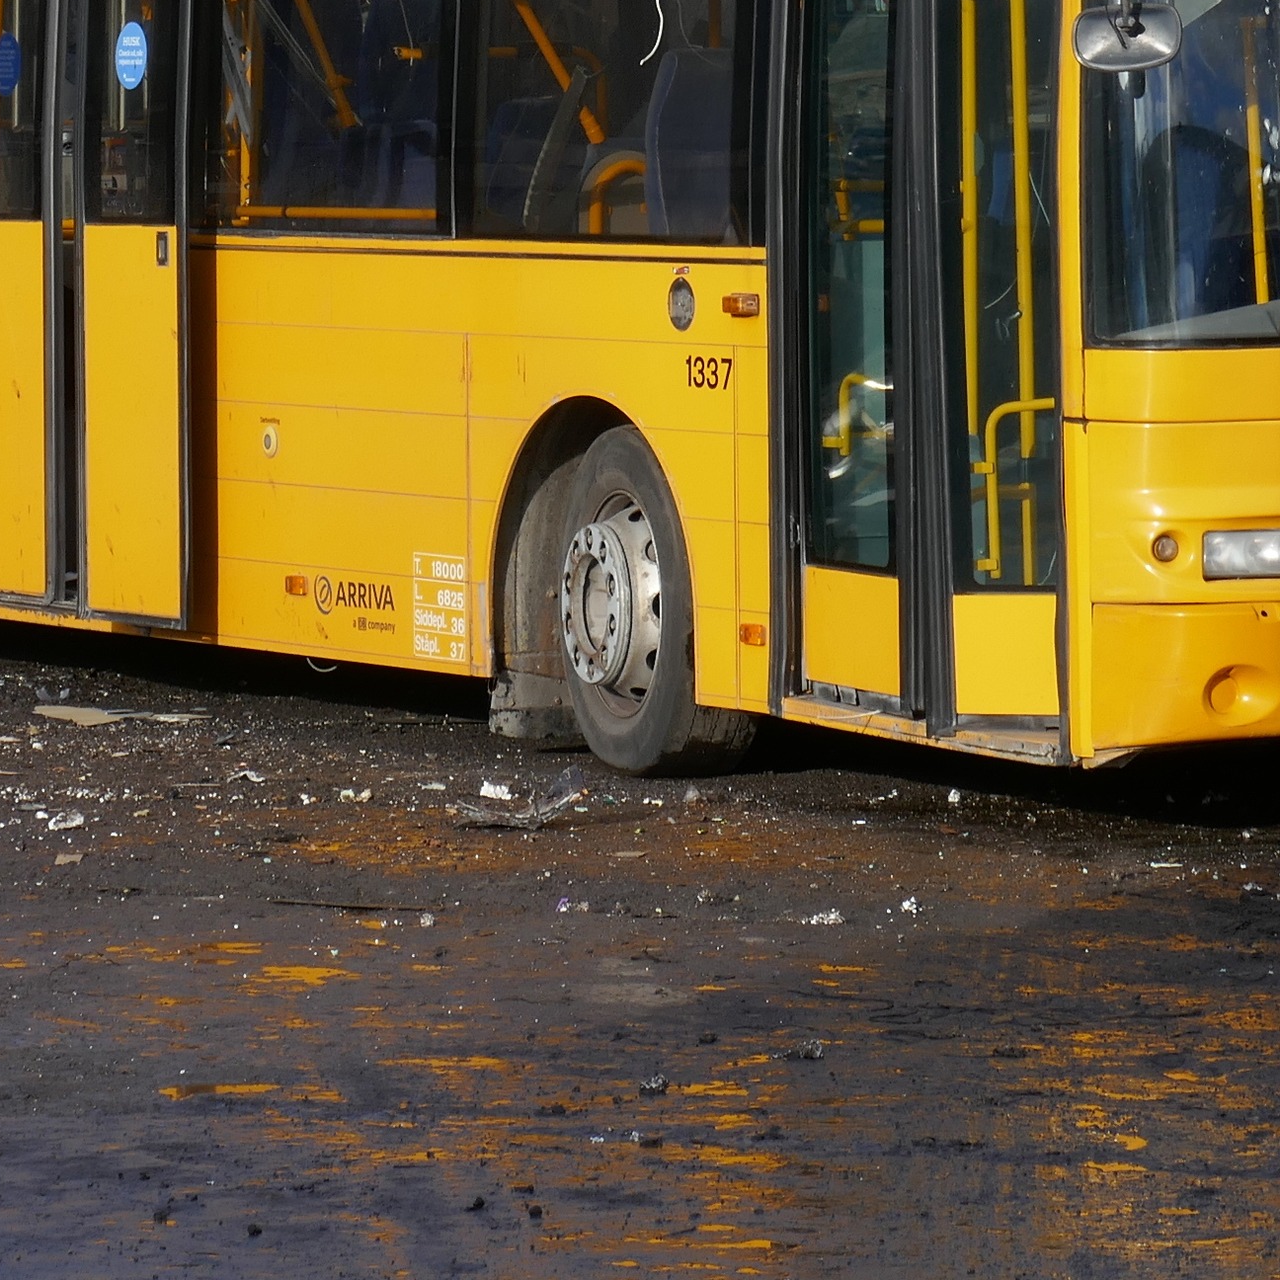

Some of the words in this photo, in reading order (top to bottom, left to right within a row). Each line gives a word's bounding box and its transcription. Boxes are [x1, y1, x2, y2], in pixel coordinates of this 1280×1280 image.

[686, 355, 732, 390] 1337
[414, 558, 422, 574] T.
[432, 561, 464, 580] 18000
[335, 581, 395, 611] ARRIVA
[415, 584, 423, 600] L.
[437, 589, 464, 609] 6825
[368, 621, 396, 635] company
[415, 609, 447, 632] Siddepl.
[451, 617, 465, 635] 36
[415, 633, 440, 657] Ståpl.
[450, 642, 465, 659] 37
